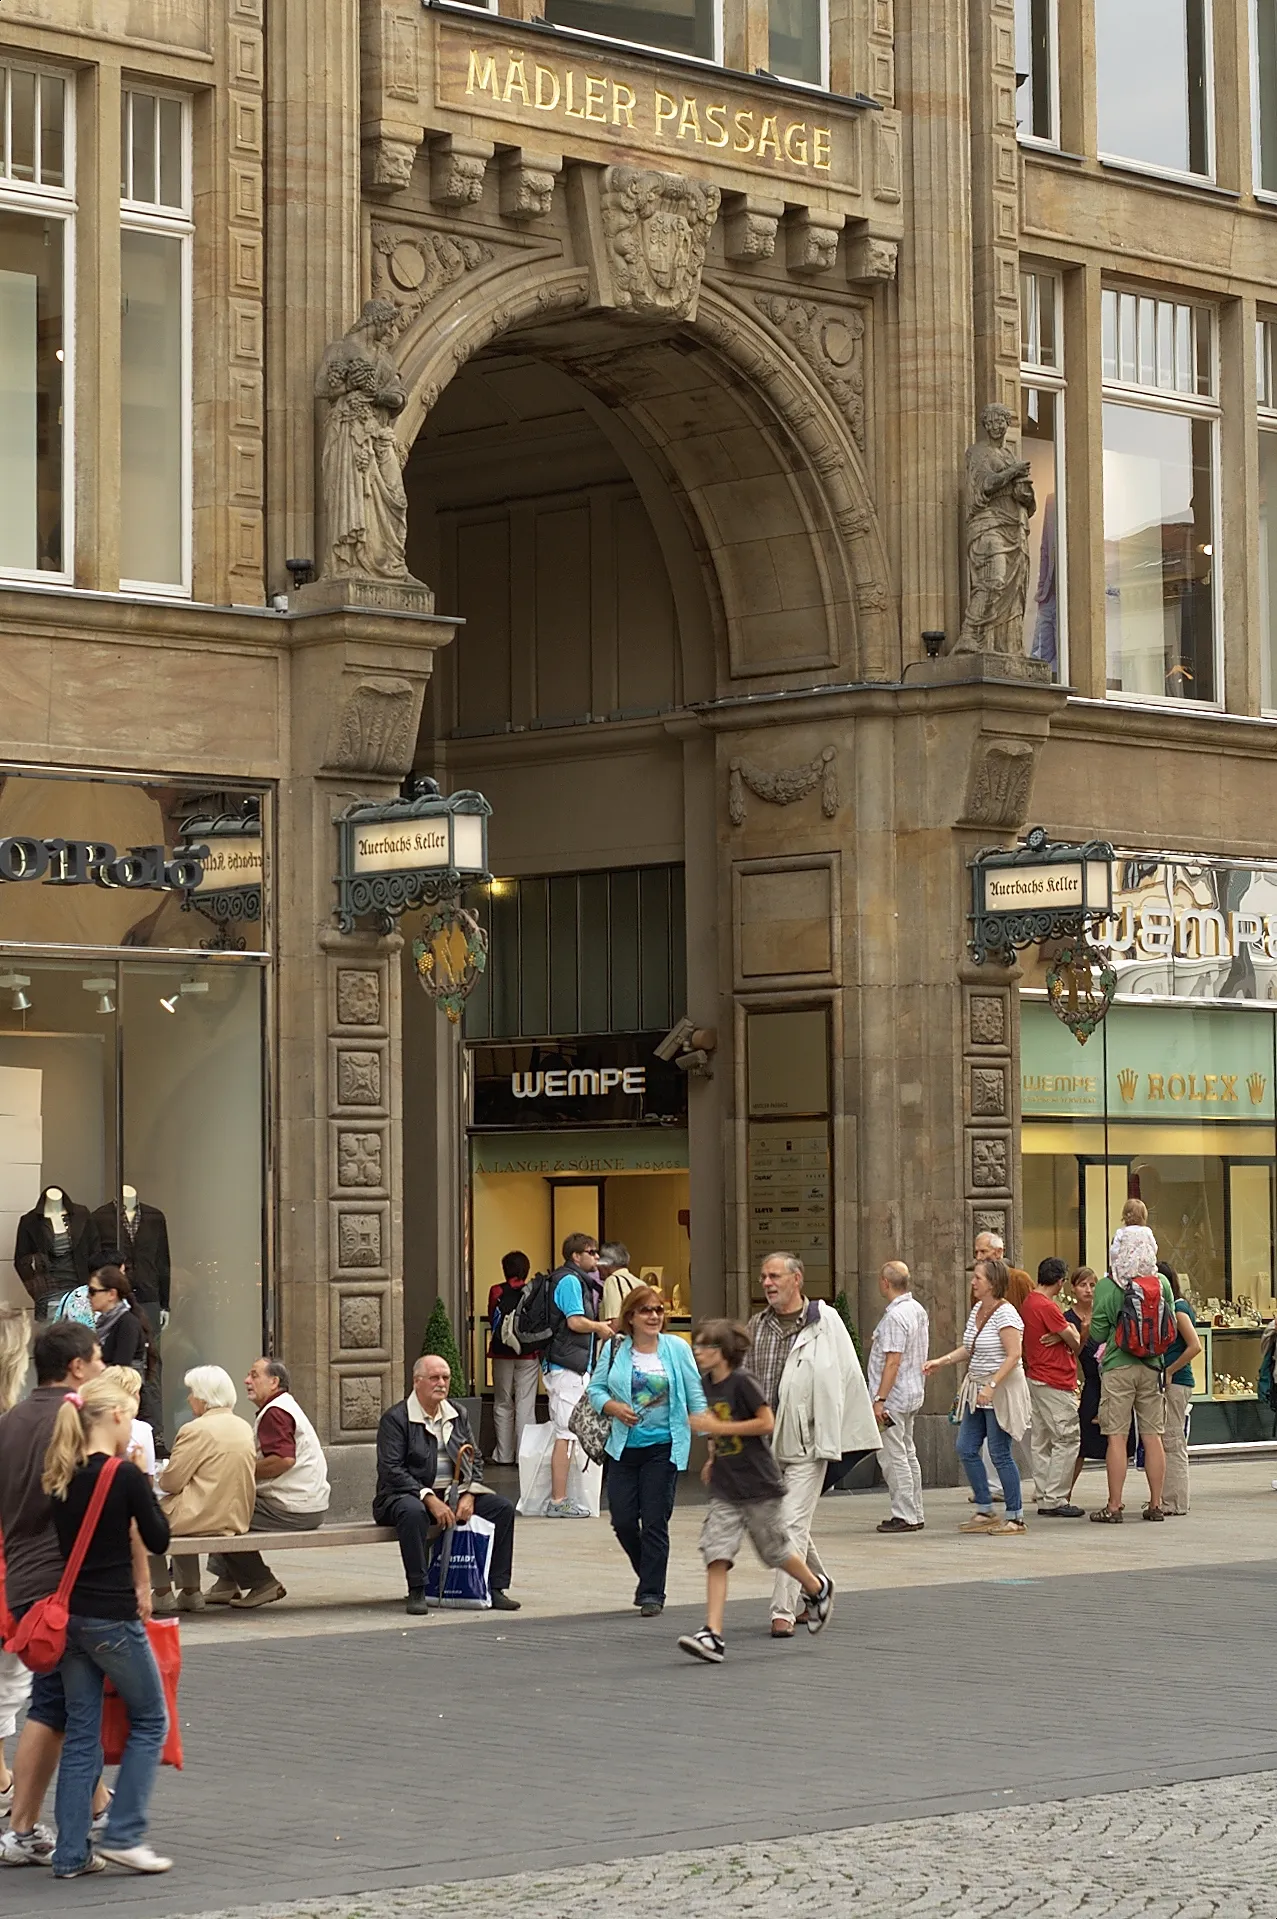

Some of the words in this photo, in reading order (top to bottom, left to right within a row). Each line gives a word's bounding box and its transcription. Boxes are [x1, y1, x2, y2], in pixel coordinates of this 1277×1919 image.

[464, 49, 638, 130] MÄDLER
[654, 88, 832, 171] PASSAGE
[358, 835, 412, 856] Auerbachs
[414, 831, 446, 851] Keller
[989, 879, 1044, 896] Auerbachs
[1047, 877, 1079, 893] Keller
[511, 1066, 646, 1098] WEMPE
[1023, 1074, 1097, 1092] WEMPE
[1147, 1073, 1239, 1101] ROLEX
[494, 1160, 549, 1173] LANGE
[553, 1159, 565, 1171] &
[568, 1155, 625, 1171] SÖHNE
